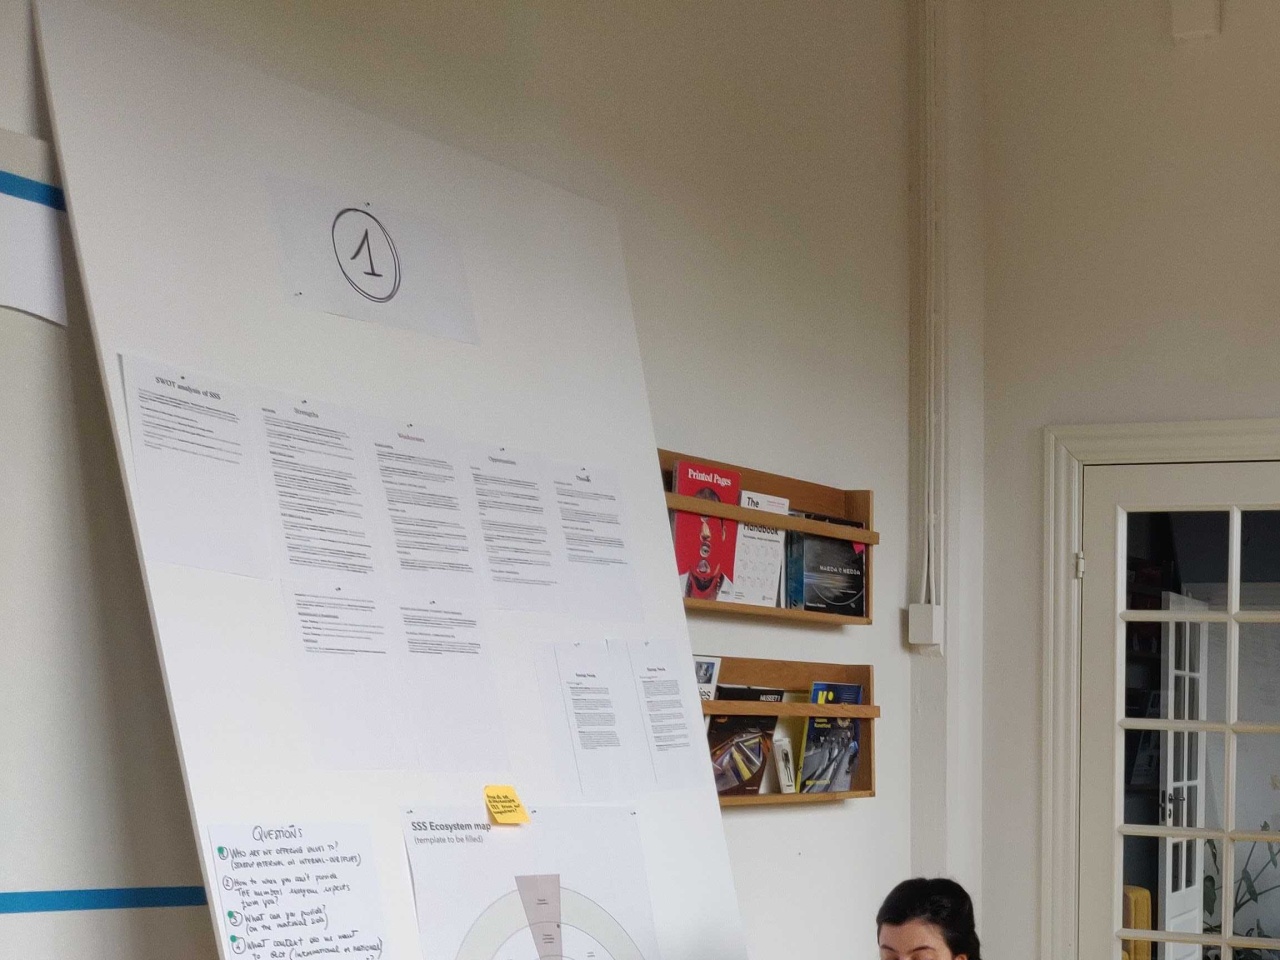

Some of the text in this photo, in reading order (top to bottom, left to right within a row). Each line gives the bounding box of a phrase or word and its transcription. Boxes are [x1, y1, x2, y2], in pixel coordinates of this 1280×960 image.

[688, 469, 732, 487] Printed Pages
[747, 497, 760, 508] The
[252, 825, 302, 842] QUESTIONS
[411, 821, 491, 833] SSS Ecosystem map
